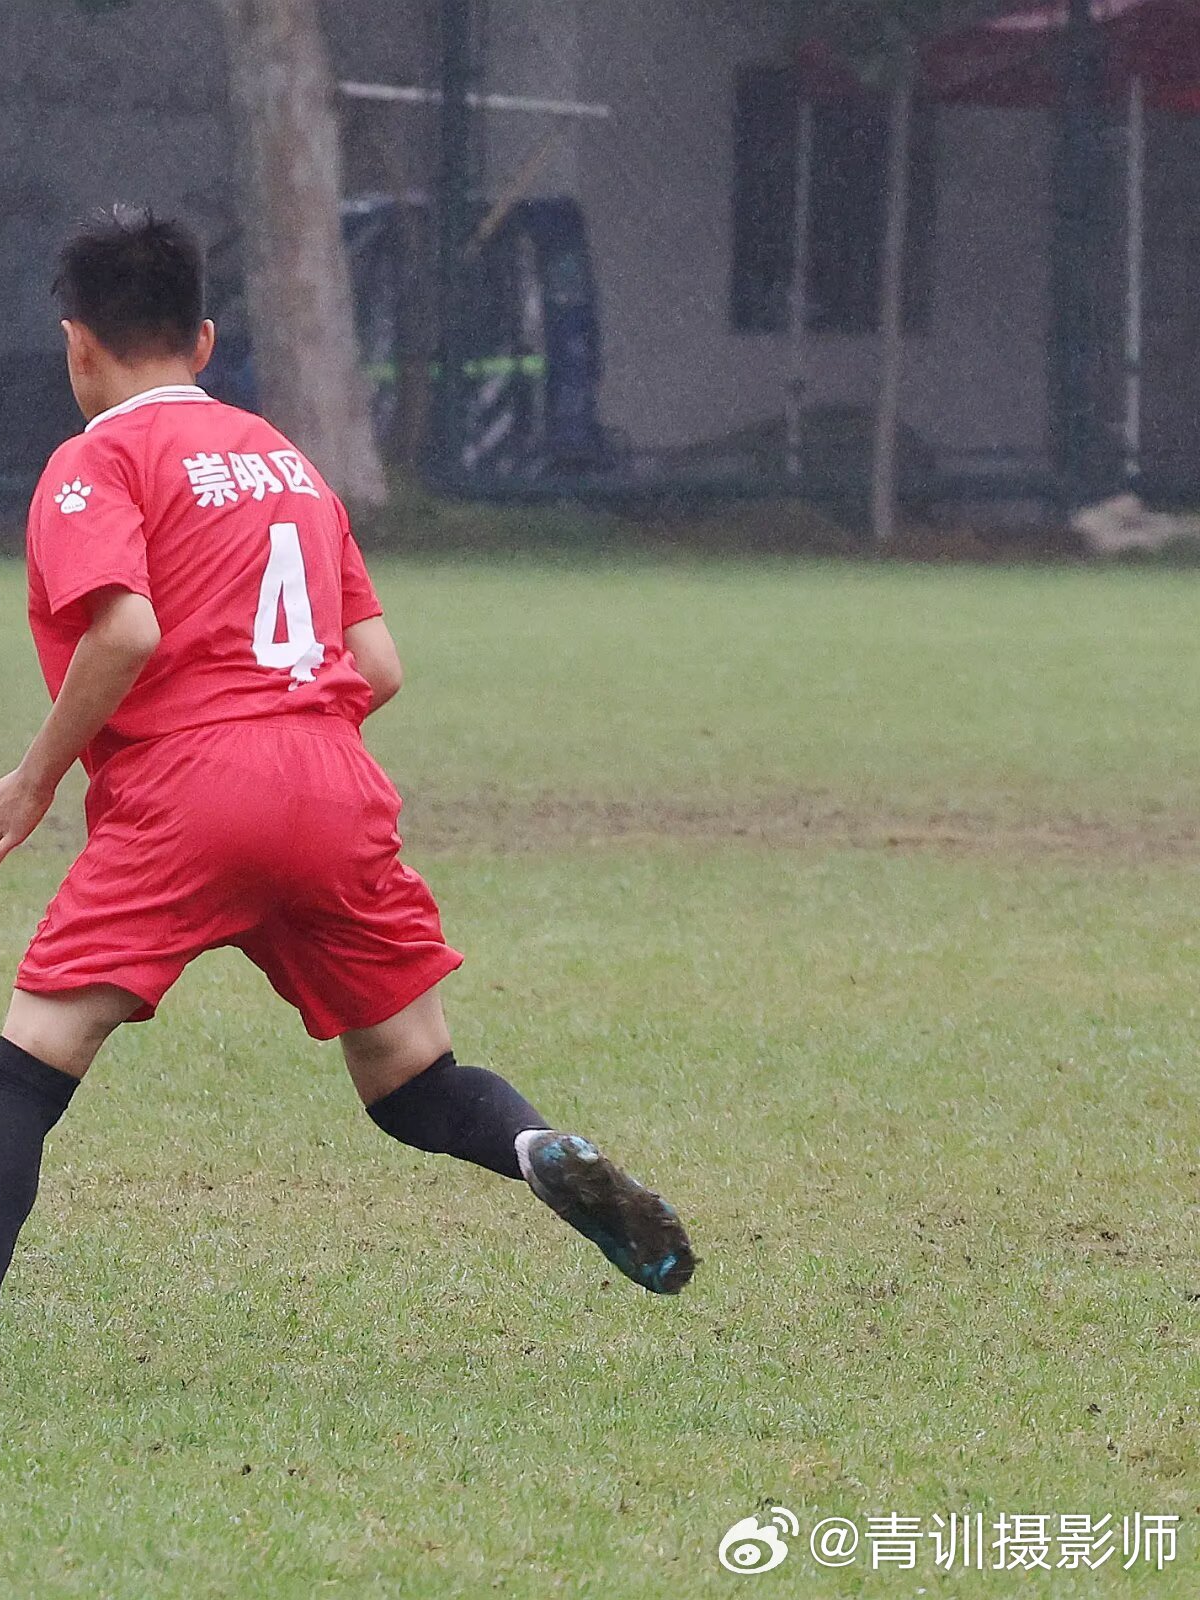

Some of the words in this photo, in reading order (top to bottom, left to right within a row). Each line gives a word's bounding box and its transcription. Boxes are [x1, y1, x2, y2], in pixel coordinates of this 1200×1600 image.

[182, 451, 320, 507] 崇明区
[252, 522, 325, 691] 4
